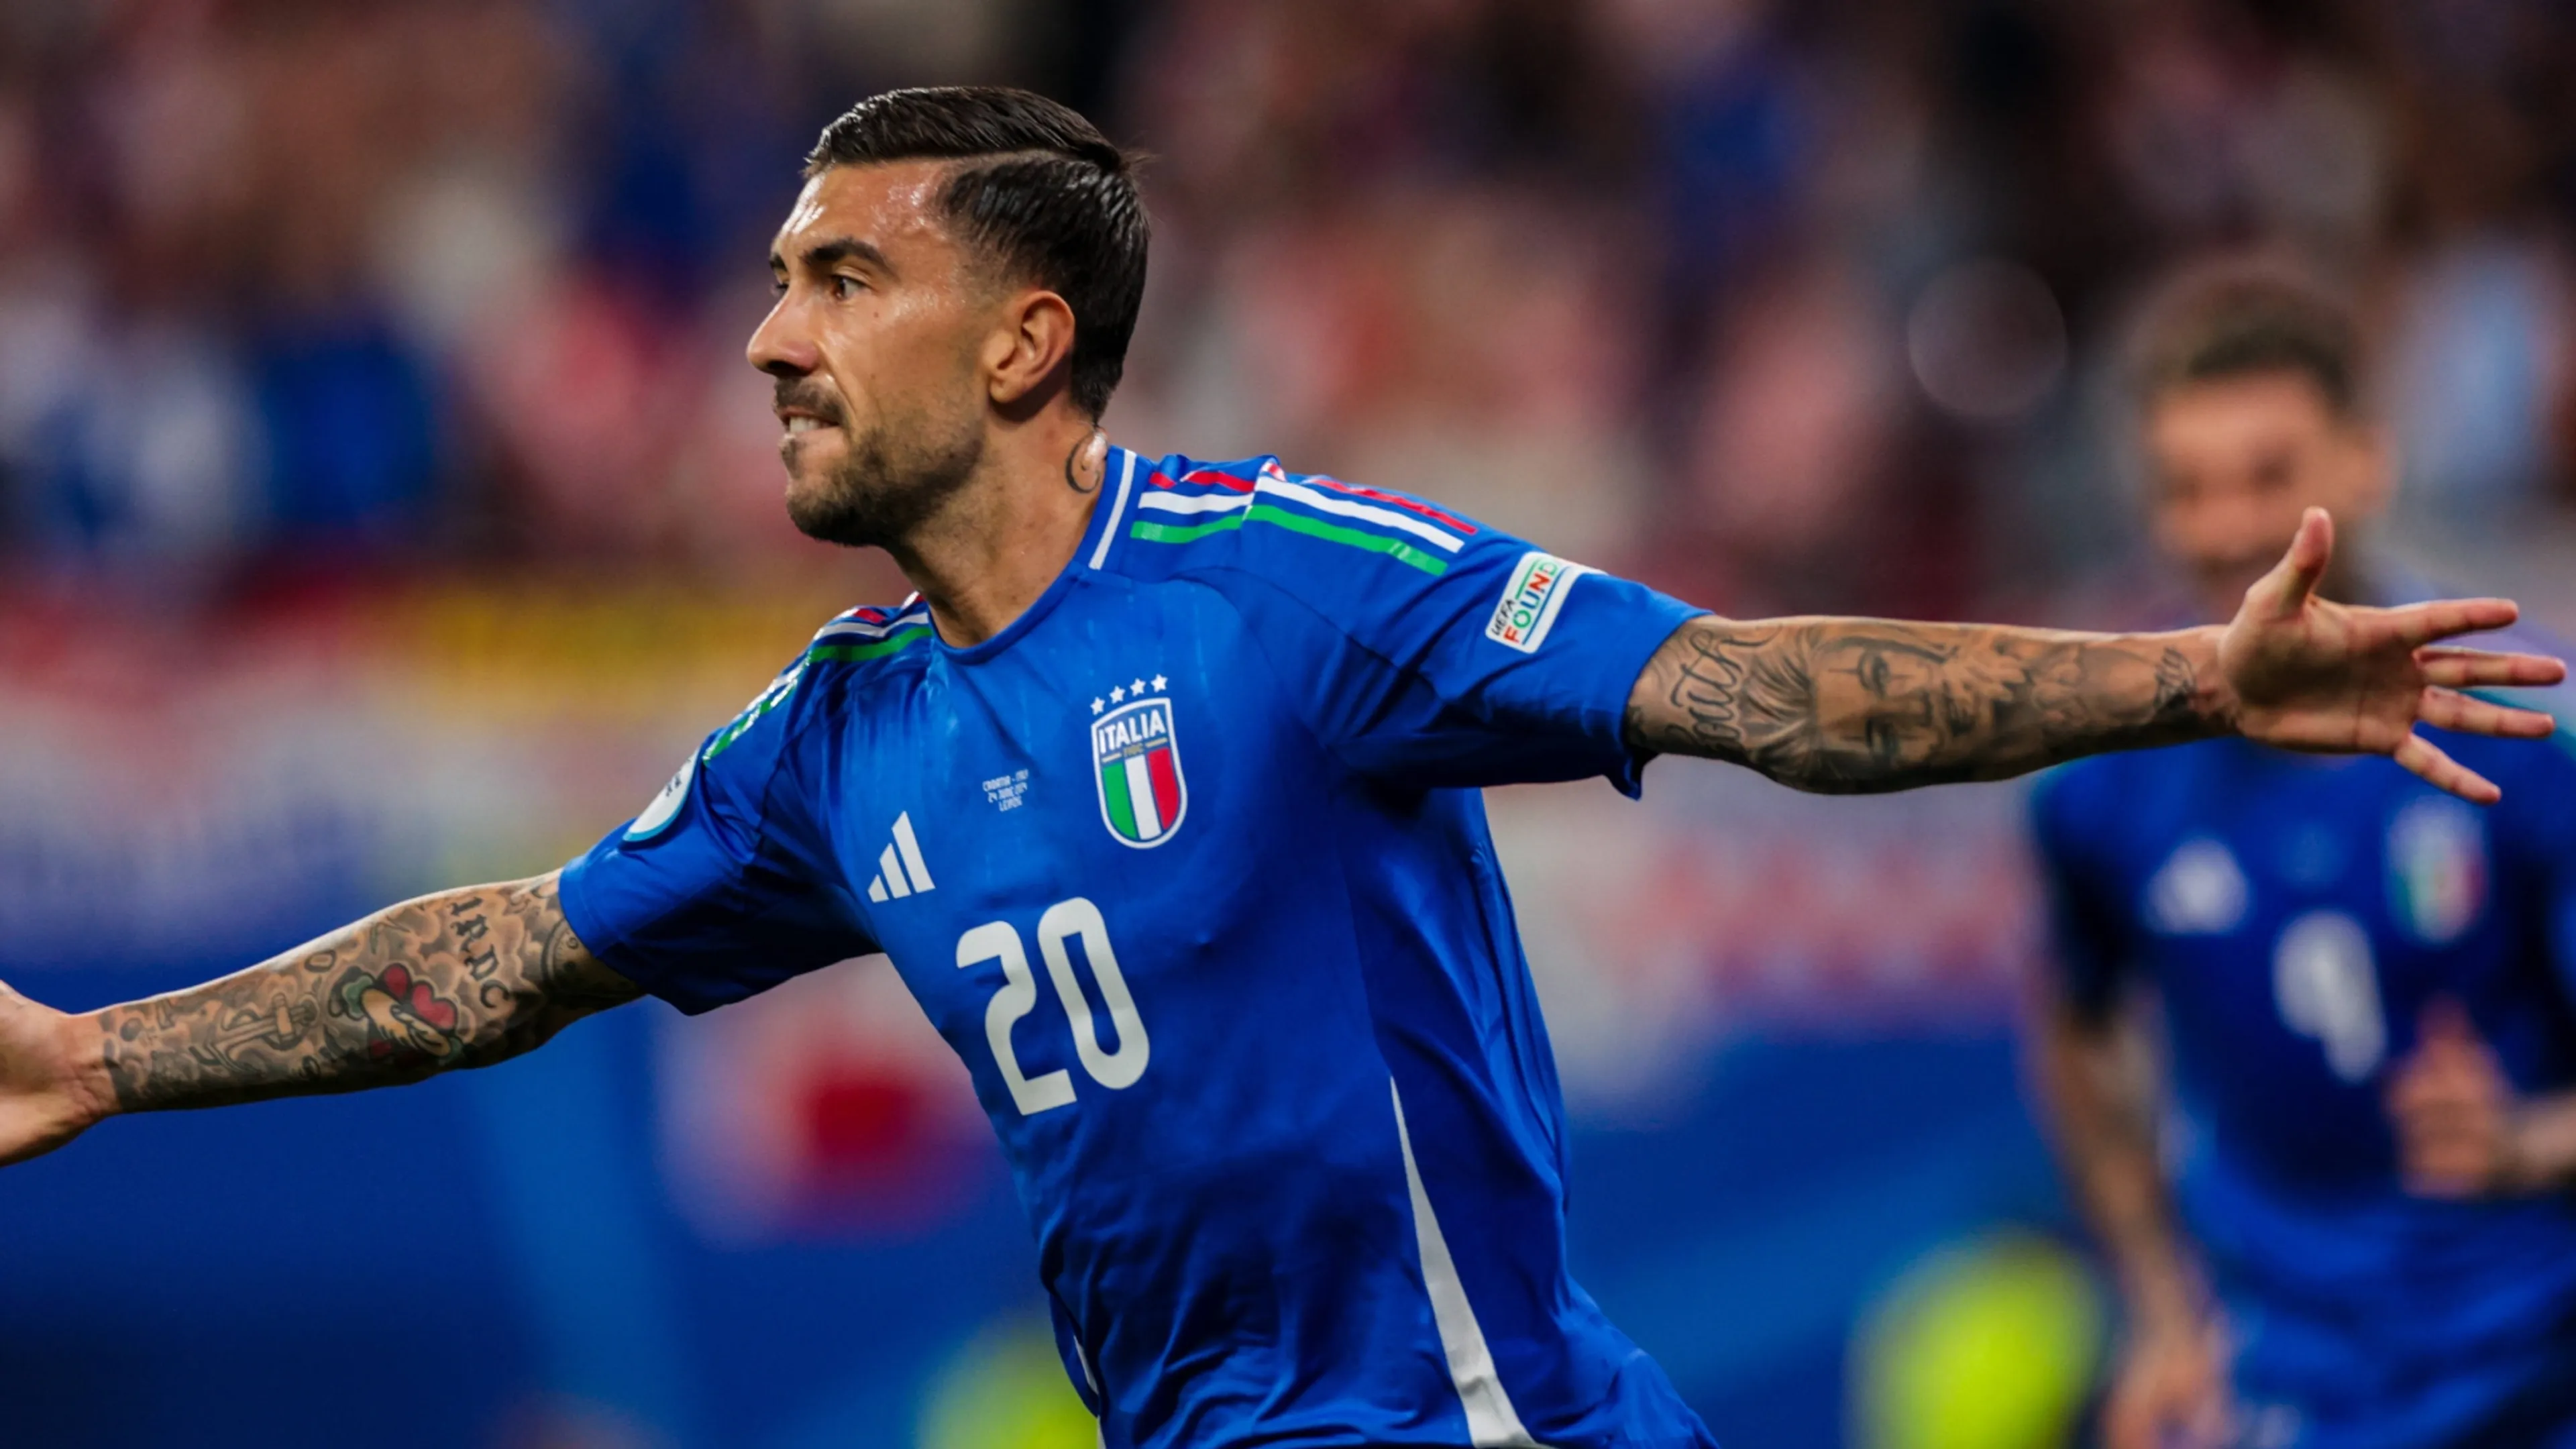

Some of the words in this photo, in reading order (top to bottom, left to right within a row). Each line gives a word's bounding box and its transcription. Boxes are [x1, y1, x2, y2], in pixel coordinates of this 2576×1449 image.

[1491, 598, 1515, 637] UEFA
[1098, 709, 1167, 754] ITALIA
[956, 896, 1150, 1116] 20
[2274, 910, 2385, 1083] 9
